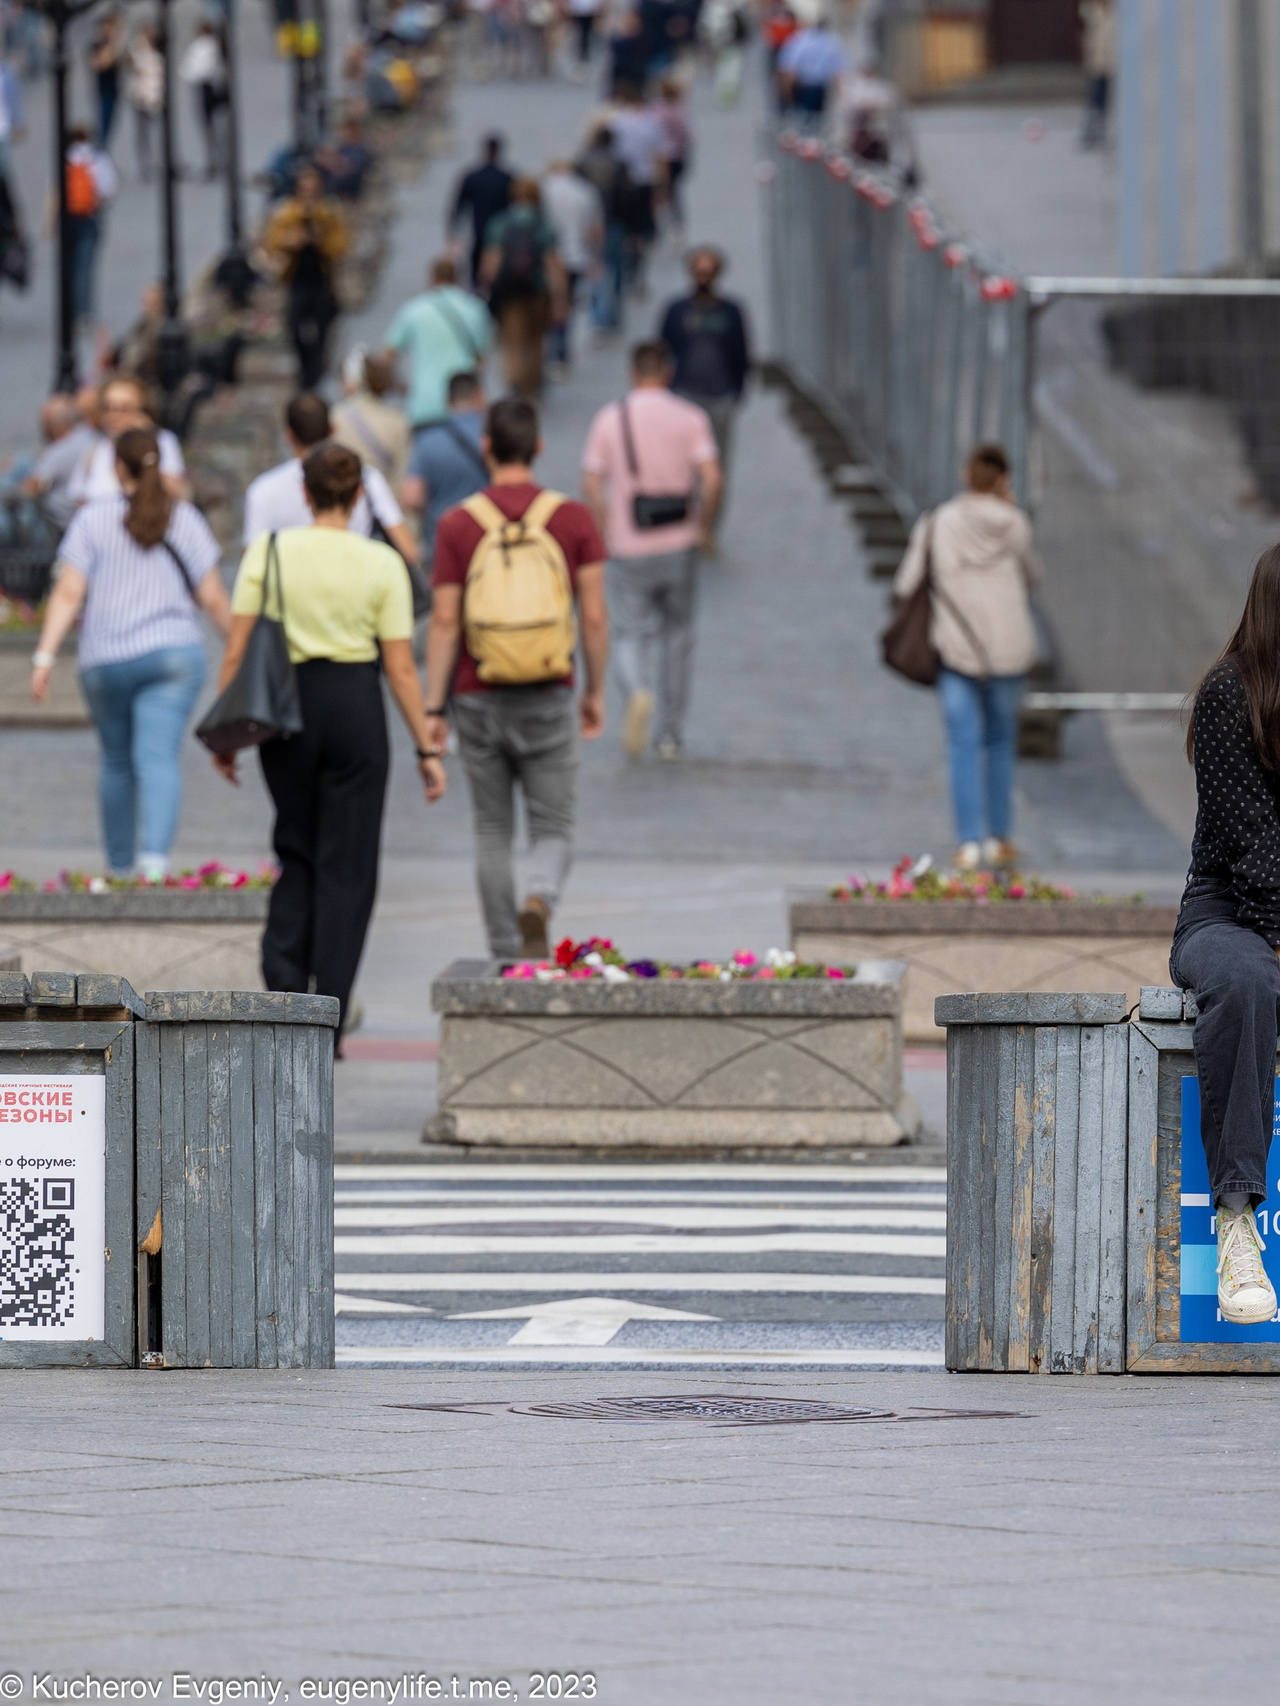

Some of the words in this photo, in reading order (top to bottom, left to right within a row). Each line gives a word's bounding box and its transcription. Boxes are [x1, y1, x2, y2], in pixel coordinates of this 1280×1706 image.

[0, 1091, 73, 1106] ВСКИЕ
[4, 1158, 14, 1167] о
[16, 1155, 76, 1170] форуме:
